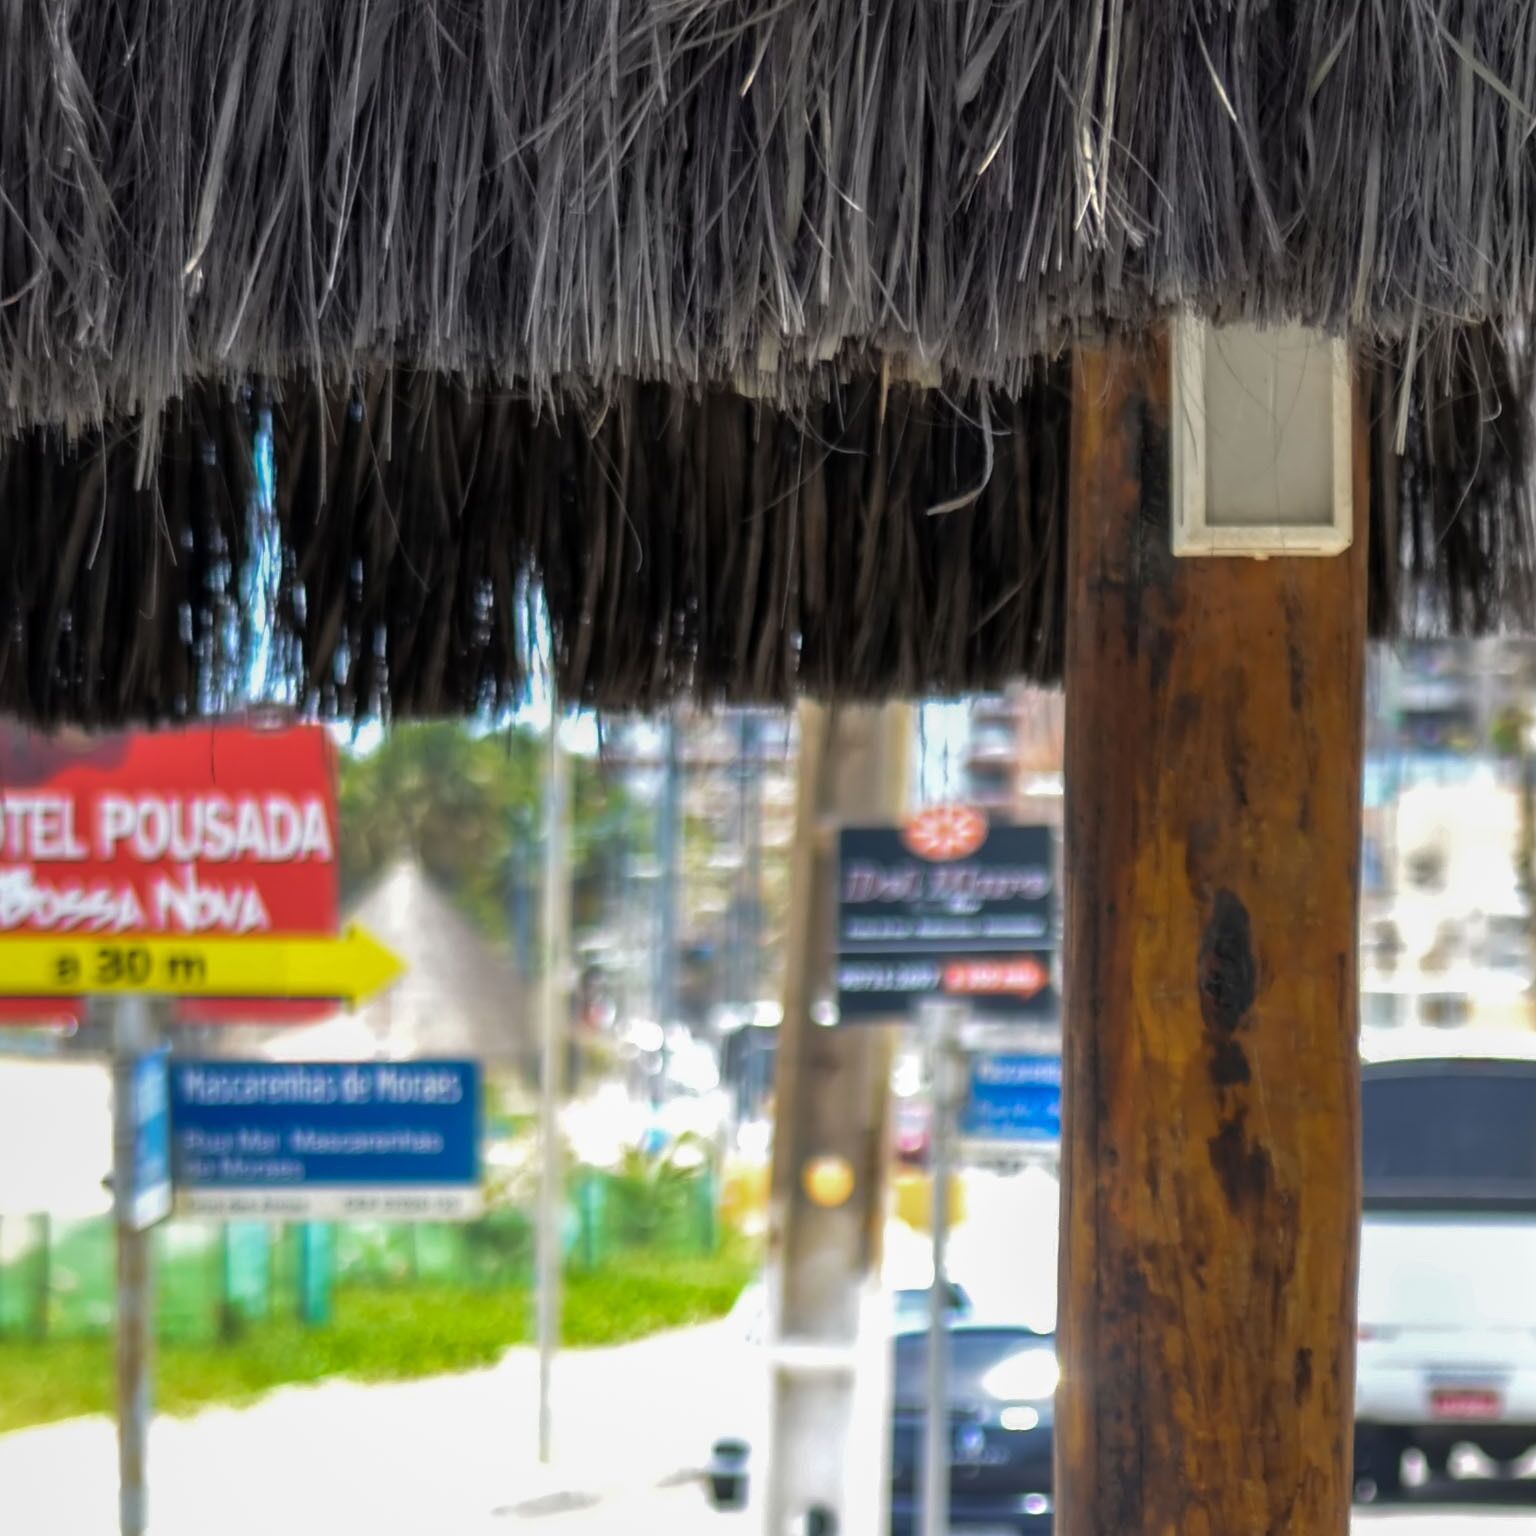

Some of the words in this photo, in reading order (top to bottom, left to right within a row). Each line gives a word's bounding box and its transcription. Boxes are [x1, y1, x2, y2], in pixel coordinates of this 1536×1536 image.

[0, 796, 88, 861] TEL
[98, 795, 334, 862] POUSADA
[55, 953, 81, 986] a
[96, 947, 151, 986] 30
[167, 952, 207, 984] m
